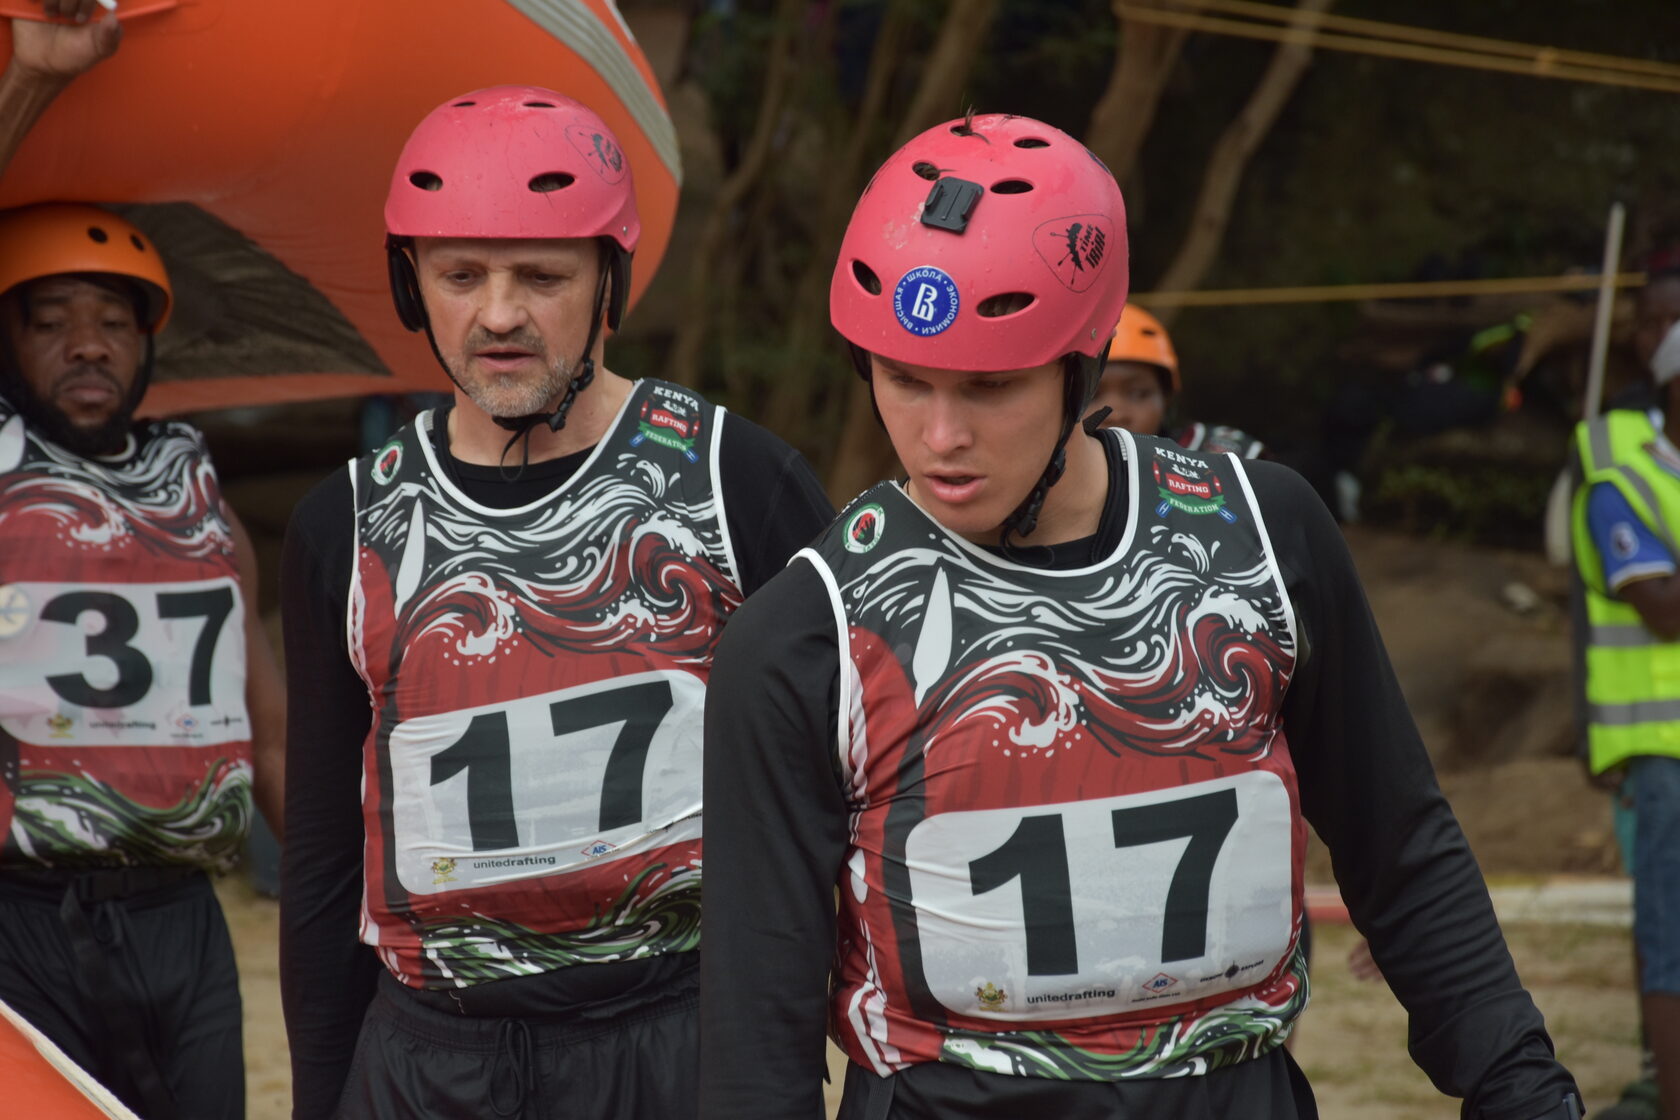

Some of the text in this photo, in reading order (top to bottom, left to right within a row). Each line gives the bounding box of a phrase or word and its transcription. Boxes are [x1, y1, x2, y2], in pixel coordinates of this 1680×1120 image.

[895, 269, 958, 335] ВЫСШАЯ ШКОЛА ЭКОНОМИКИ
[653, 386, 699, 412] KENYA
[652, 414, 687, 433] RAFTING
[1154, 446, 1209, 469] KENYA
[1168, 479, 1209, 493] RAFTING
[1169, 498, 1219, 513] FEDERATION
[39, 585, 234, 709] 37
[430, 680, 674, 851] 17
[473, 856, 556, 869] unitedrafting
[968, 787, 1239, 976] 17
[1027, 989, 1115, 1004] unitedrafting
